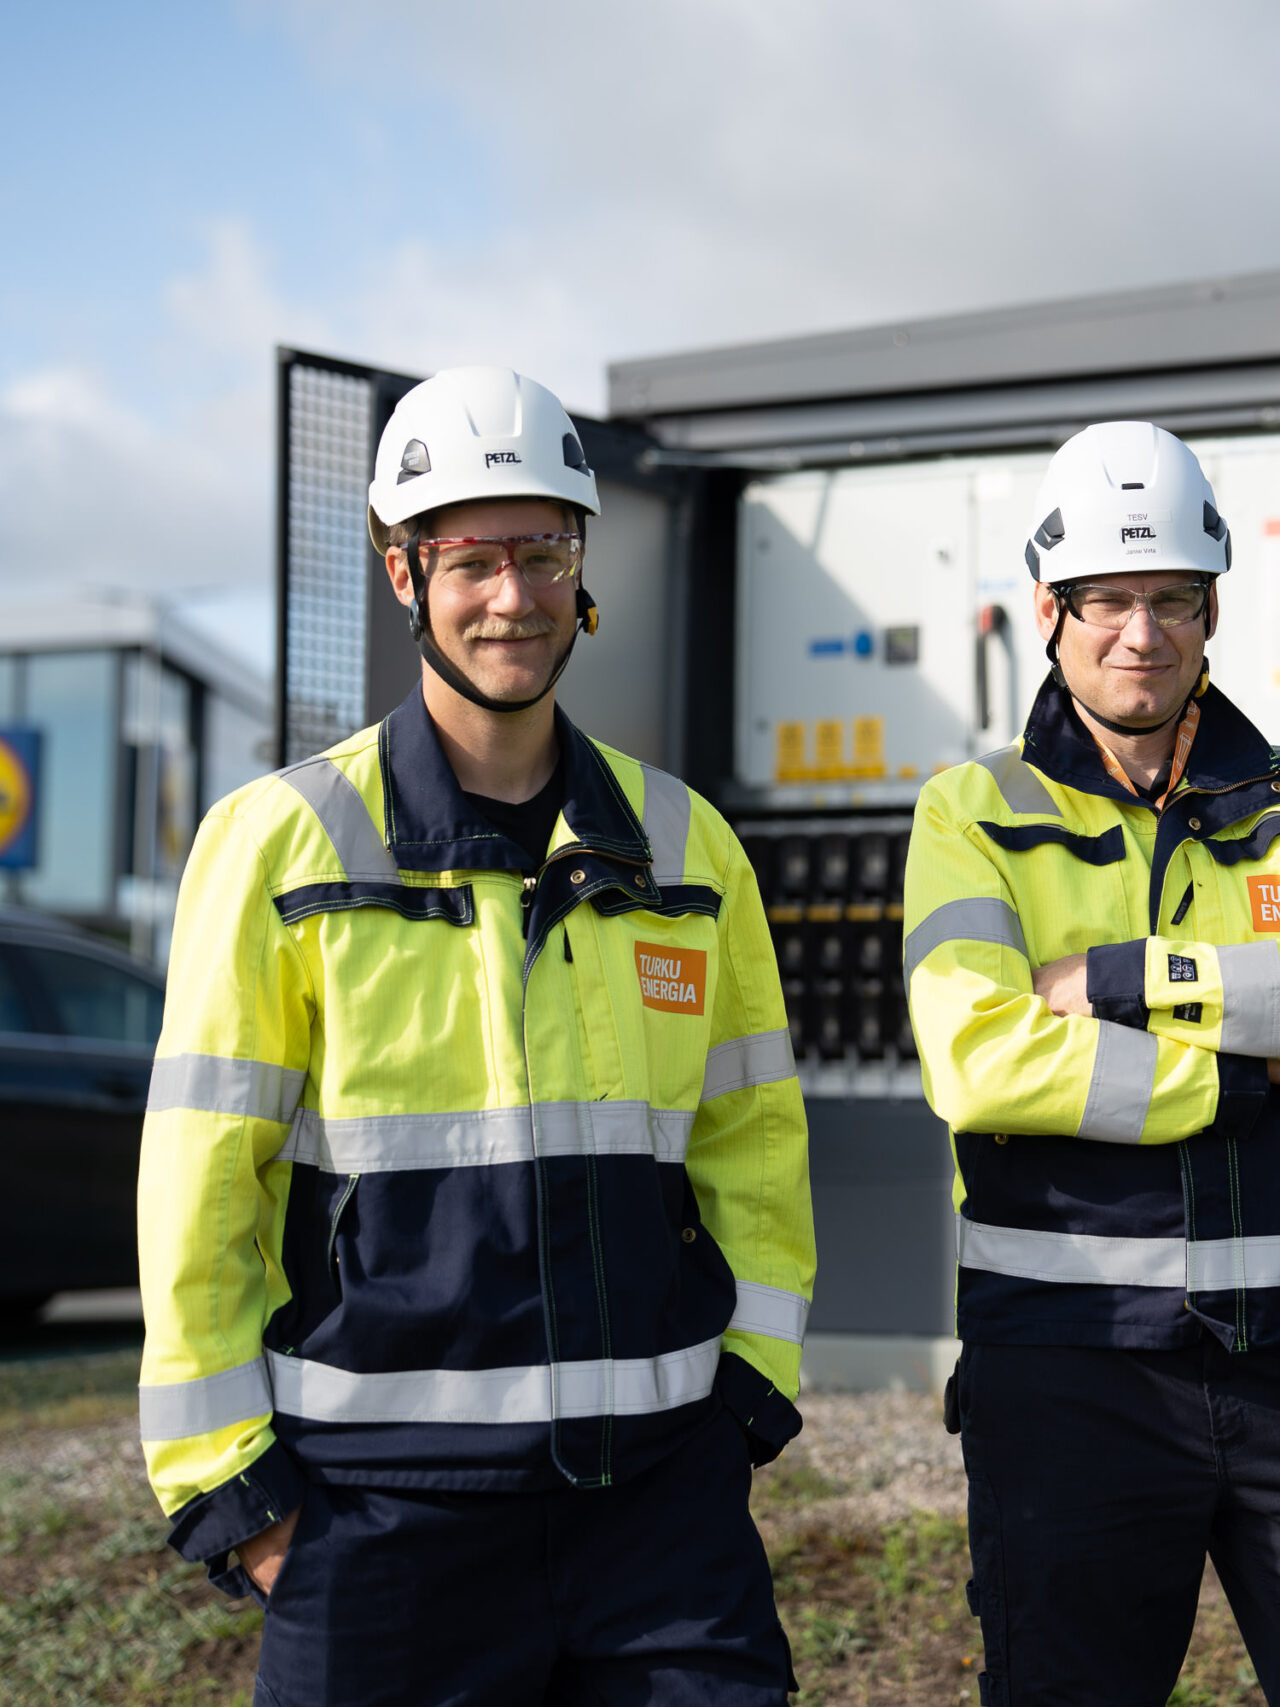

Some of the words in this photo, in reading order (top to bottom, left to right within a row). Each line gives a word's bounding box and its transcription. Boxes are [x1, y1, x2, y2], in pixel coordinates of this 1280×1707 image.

[485, 452, 522, 469] PETZL
[1128, 513, 1148, 521] TESV
[1121, 527, 1157, 544] PETZL
[639, 954, 681, 979] TURKU
[640, 976, 697, 1004] ENERGIA
